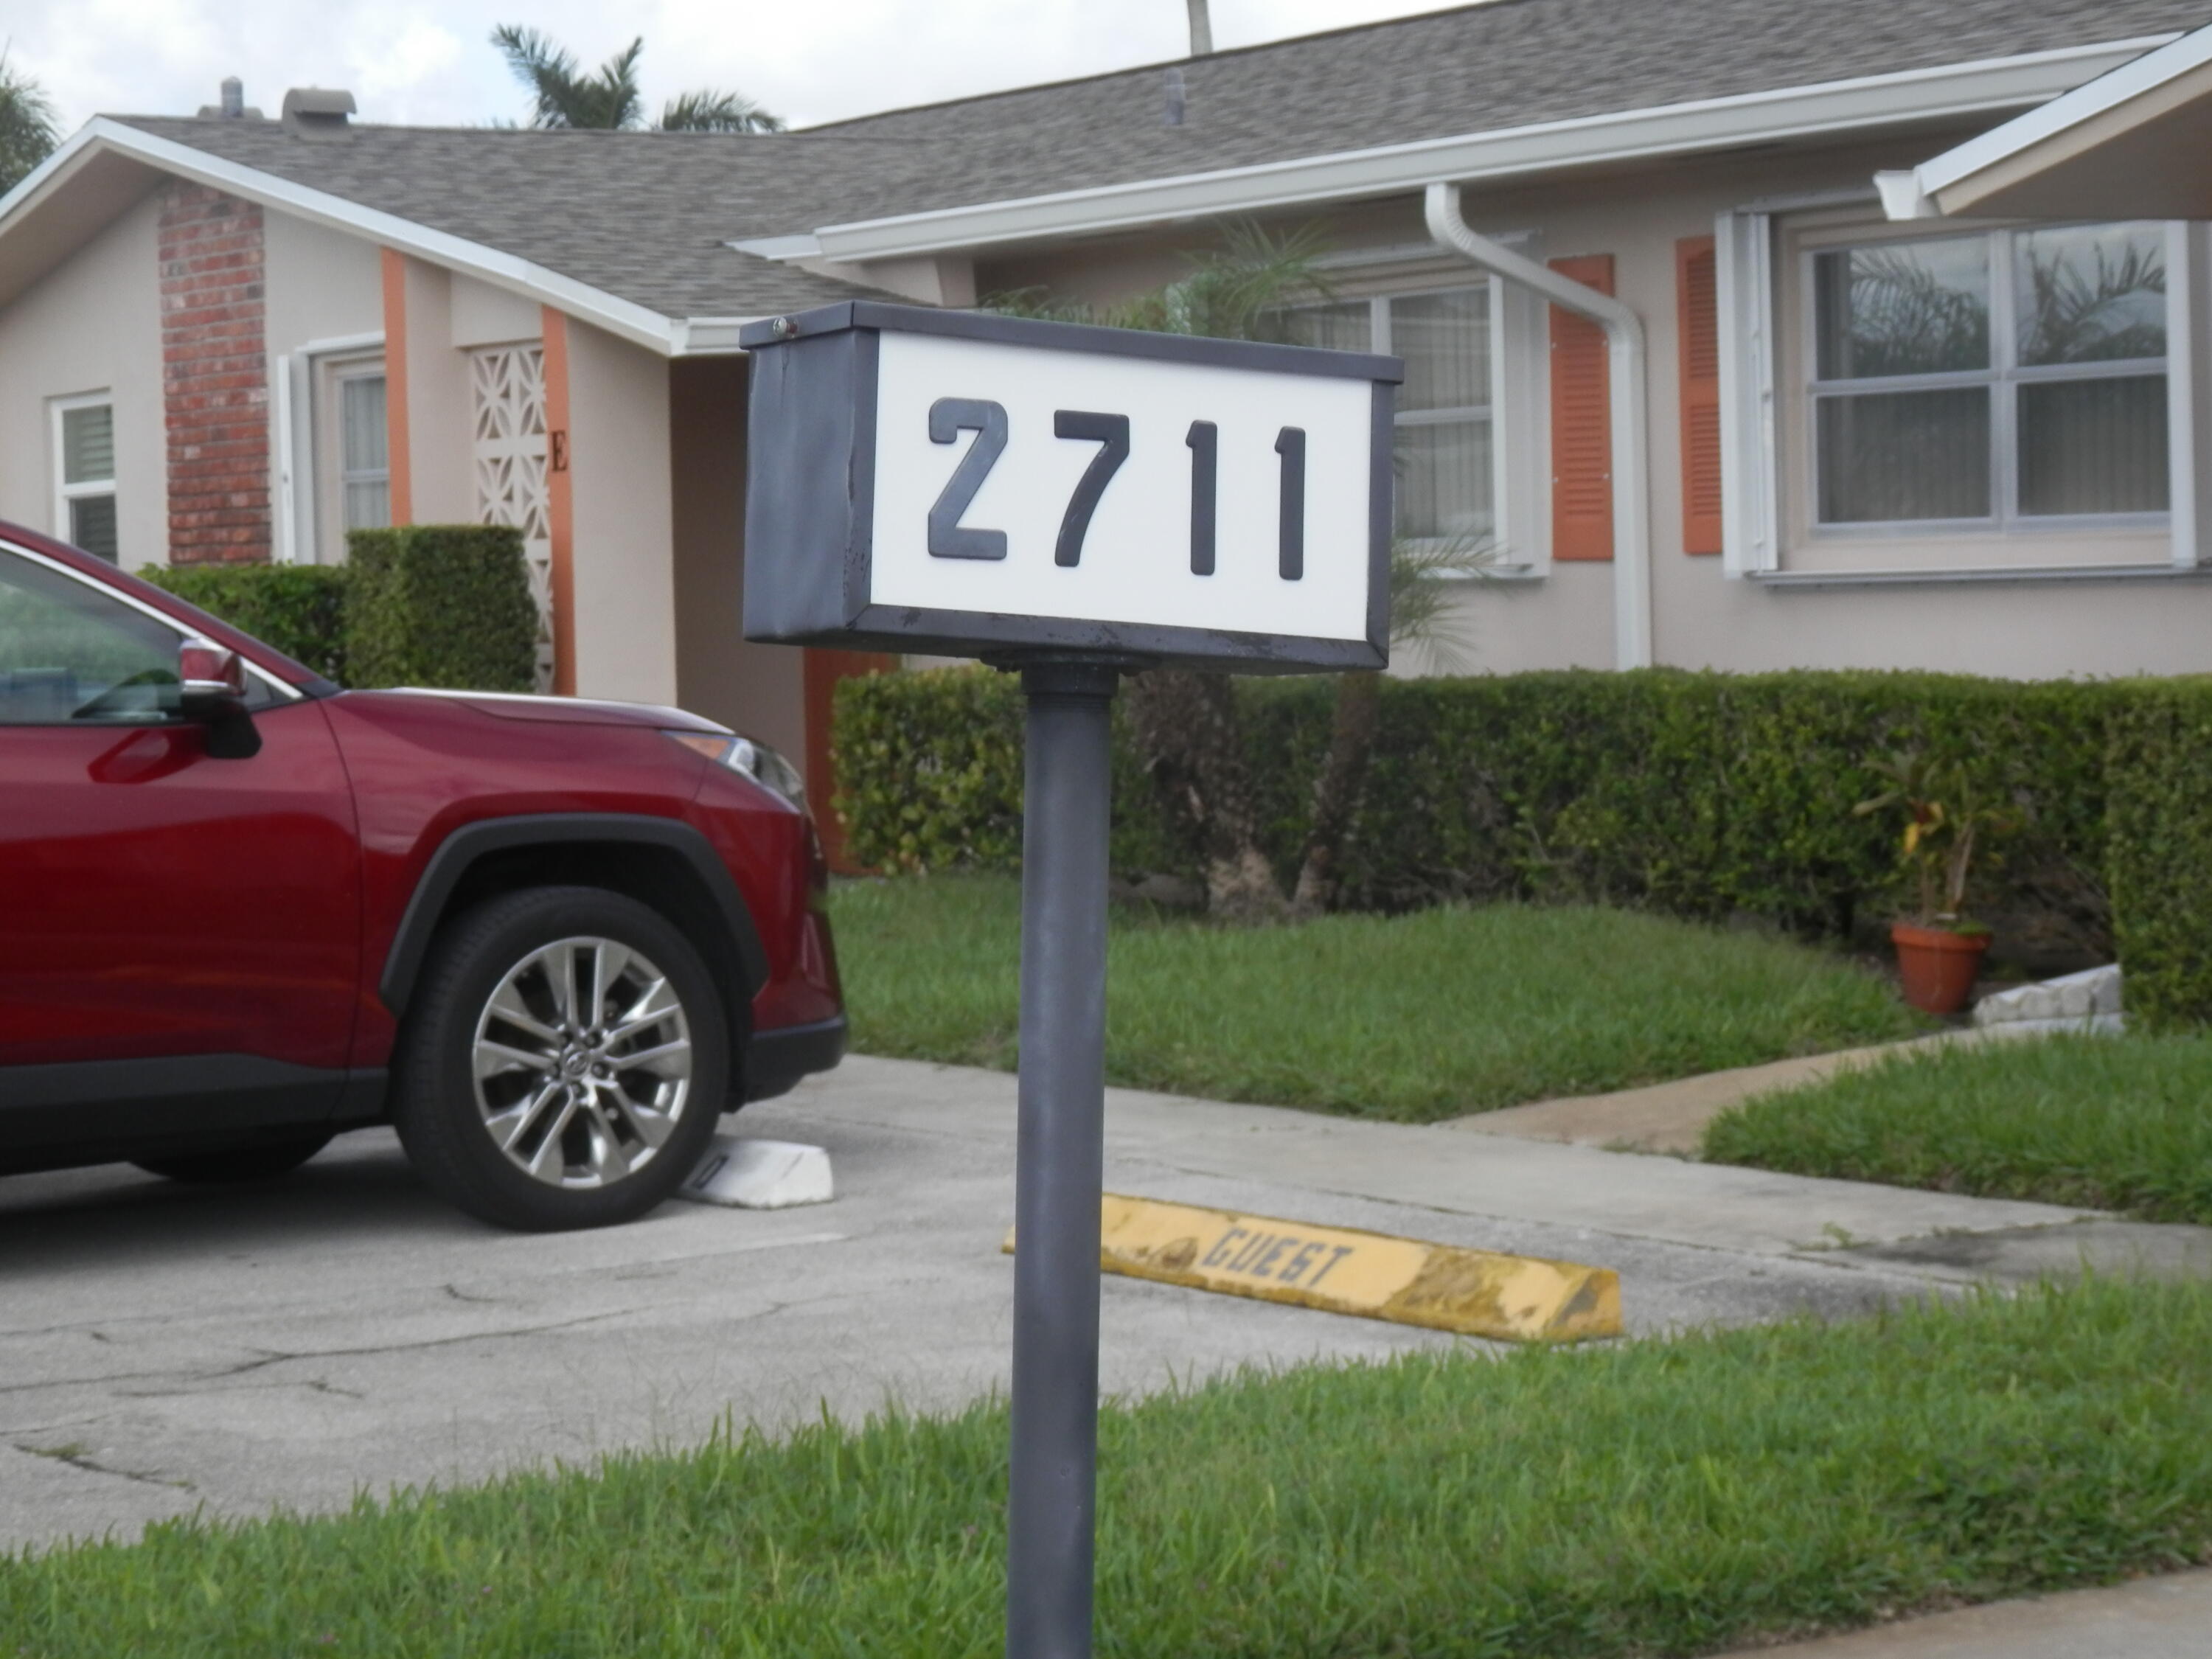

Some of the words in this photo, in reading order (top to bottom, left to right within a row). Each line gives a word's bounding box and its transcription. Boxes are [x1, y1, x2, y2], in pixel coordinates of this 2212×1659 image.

[548, 430, 568, 471] E
[928, 397, 1306, 580] 2711
[1201, 1225, 1354, 1287] GUEST
